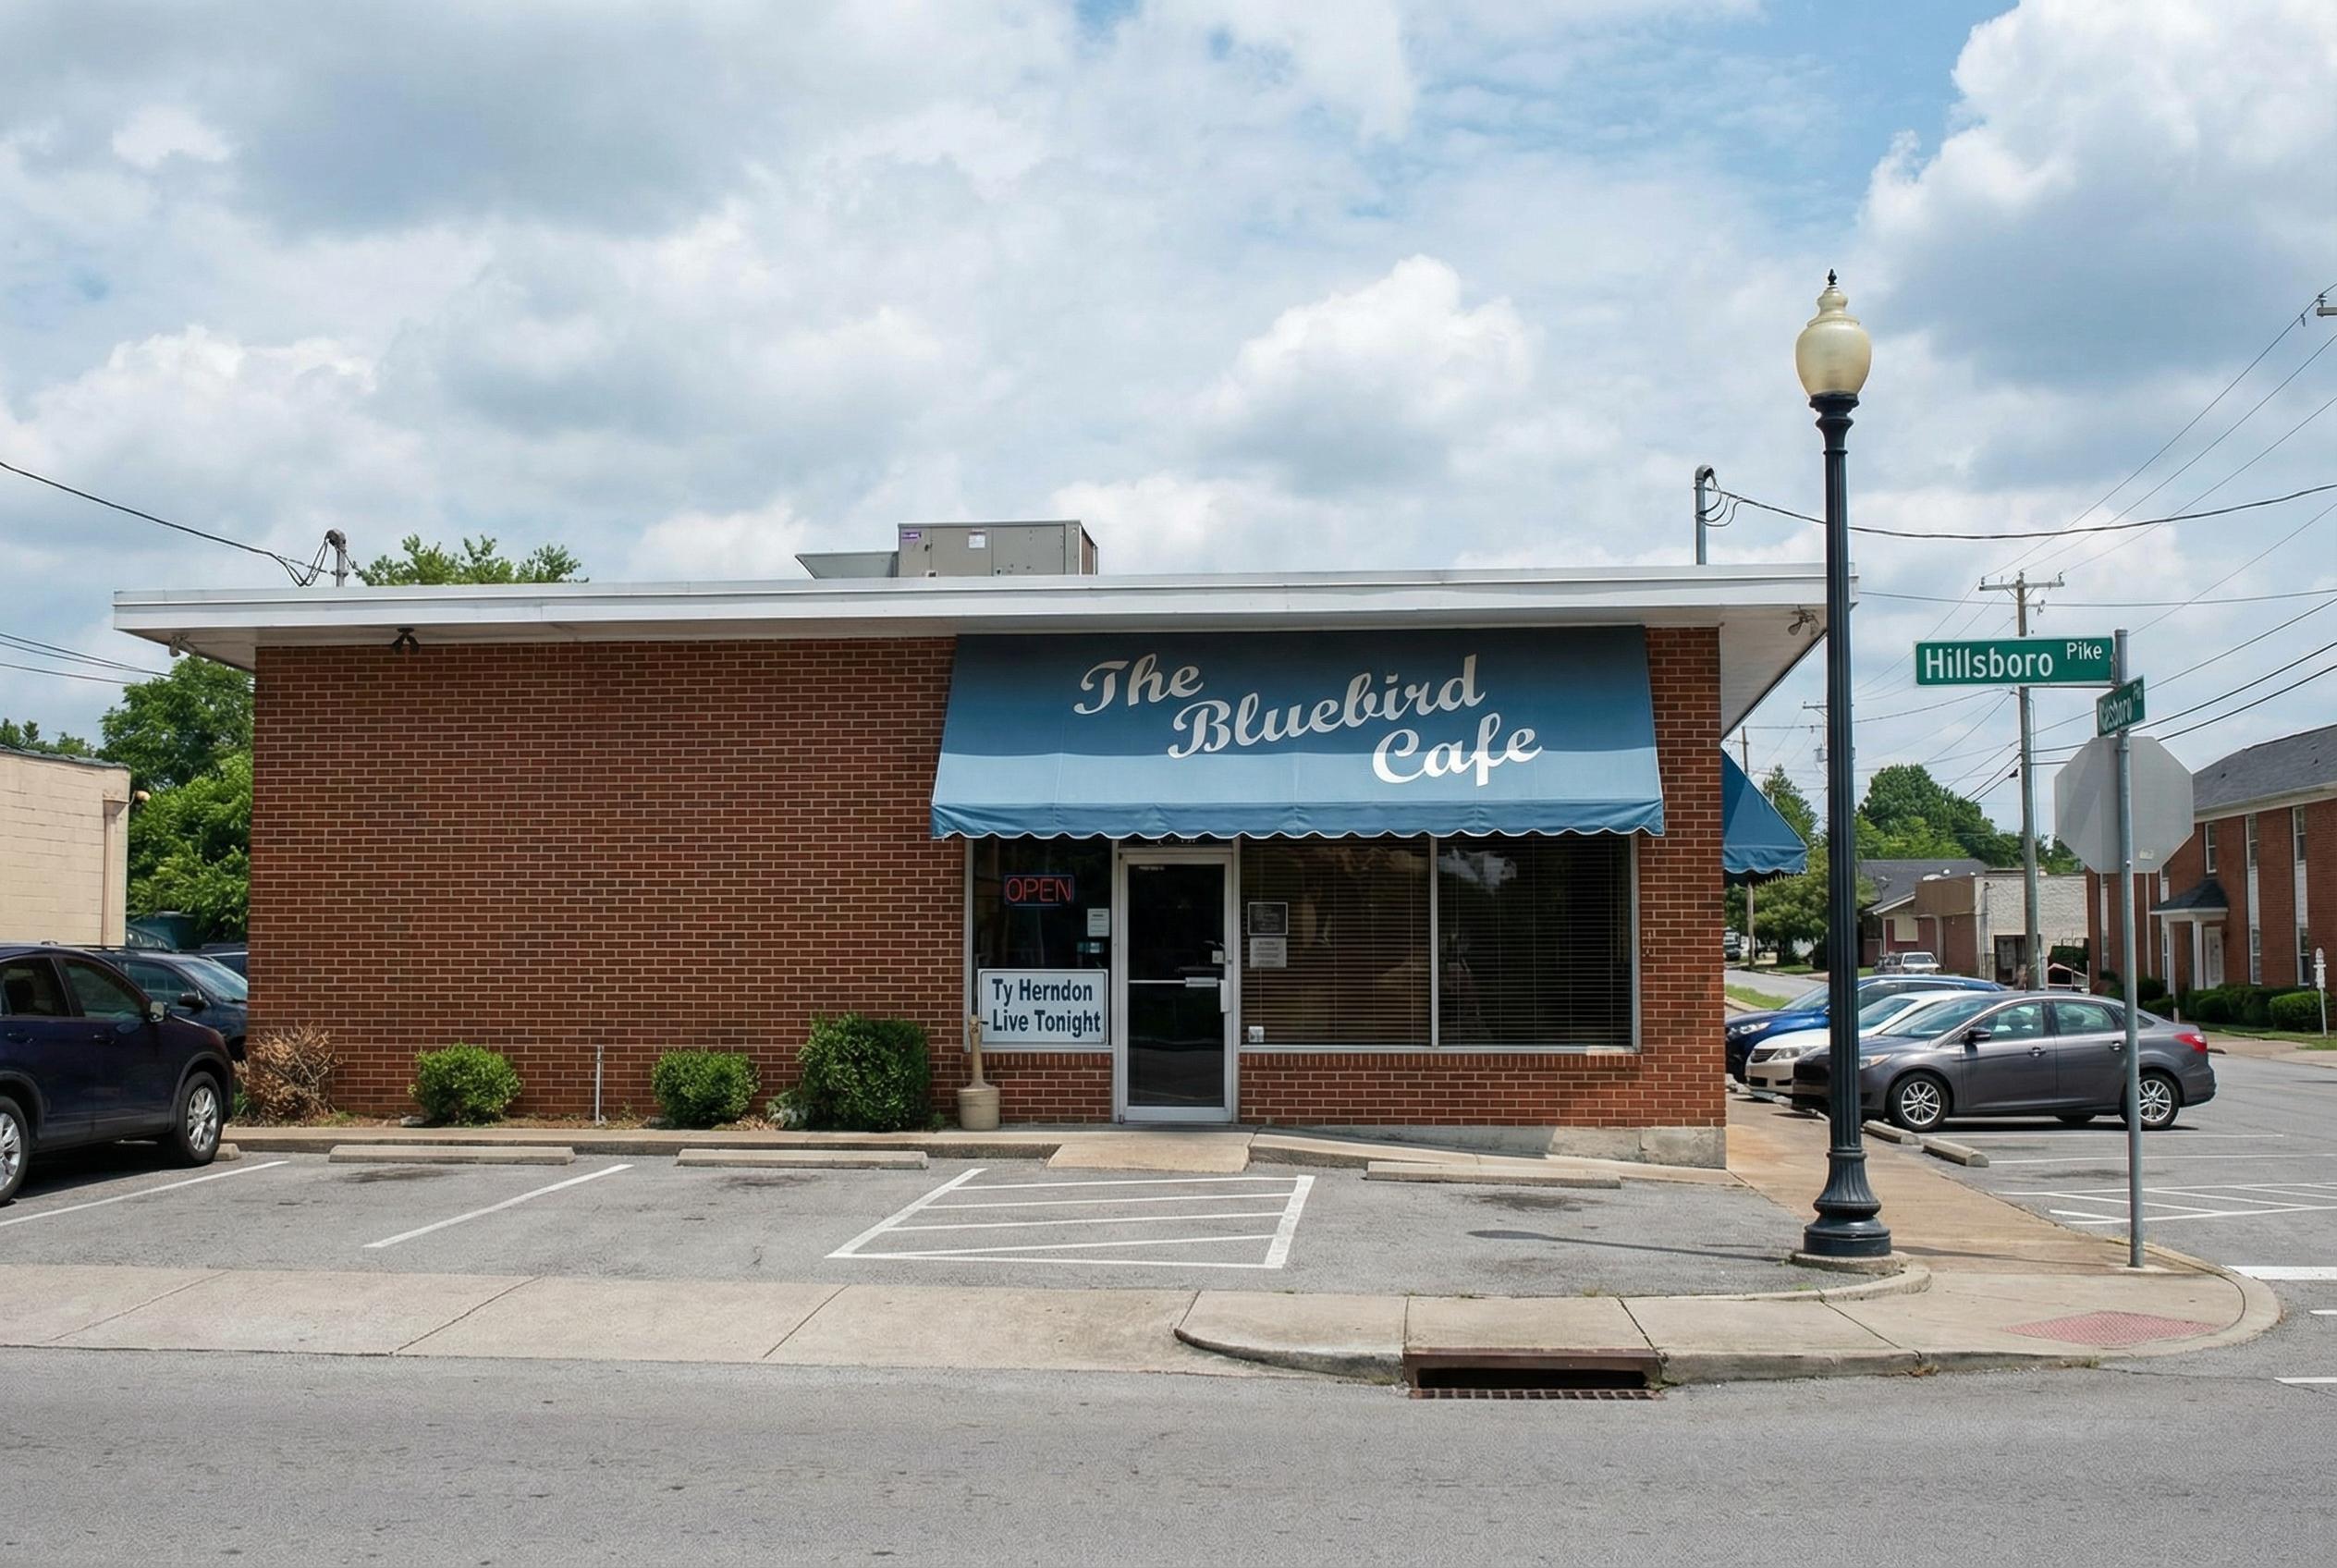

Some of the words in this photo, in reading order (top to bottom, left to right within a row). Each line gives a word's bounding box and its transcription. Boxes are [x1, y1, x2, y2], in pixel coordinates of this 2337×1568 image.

[1925, 647, 2053, 679] Hillsboro
[2066, 642, 2103, 660] Pike
[1073, 652, 1203, 716] The
[1167, 655, 1486, 759] Bluebird
[1372, 713, 1542, 787] Cafe
[1006, 878, 1071, 902] OPEN
[992, 978, 1013, 1007] Ty
[1019, 978, 1093, 1001] Herndon
[993, 1009, 1029, 1032] Live
[1034, 1010, 1101, 1038] Tonight
